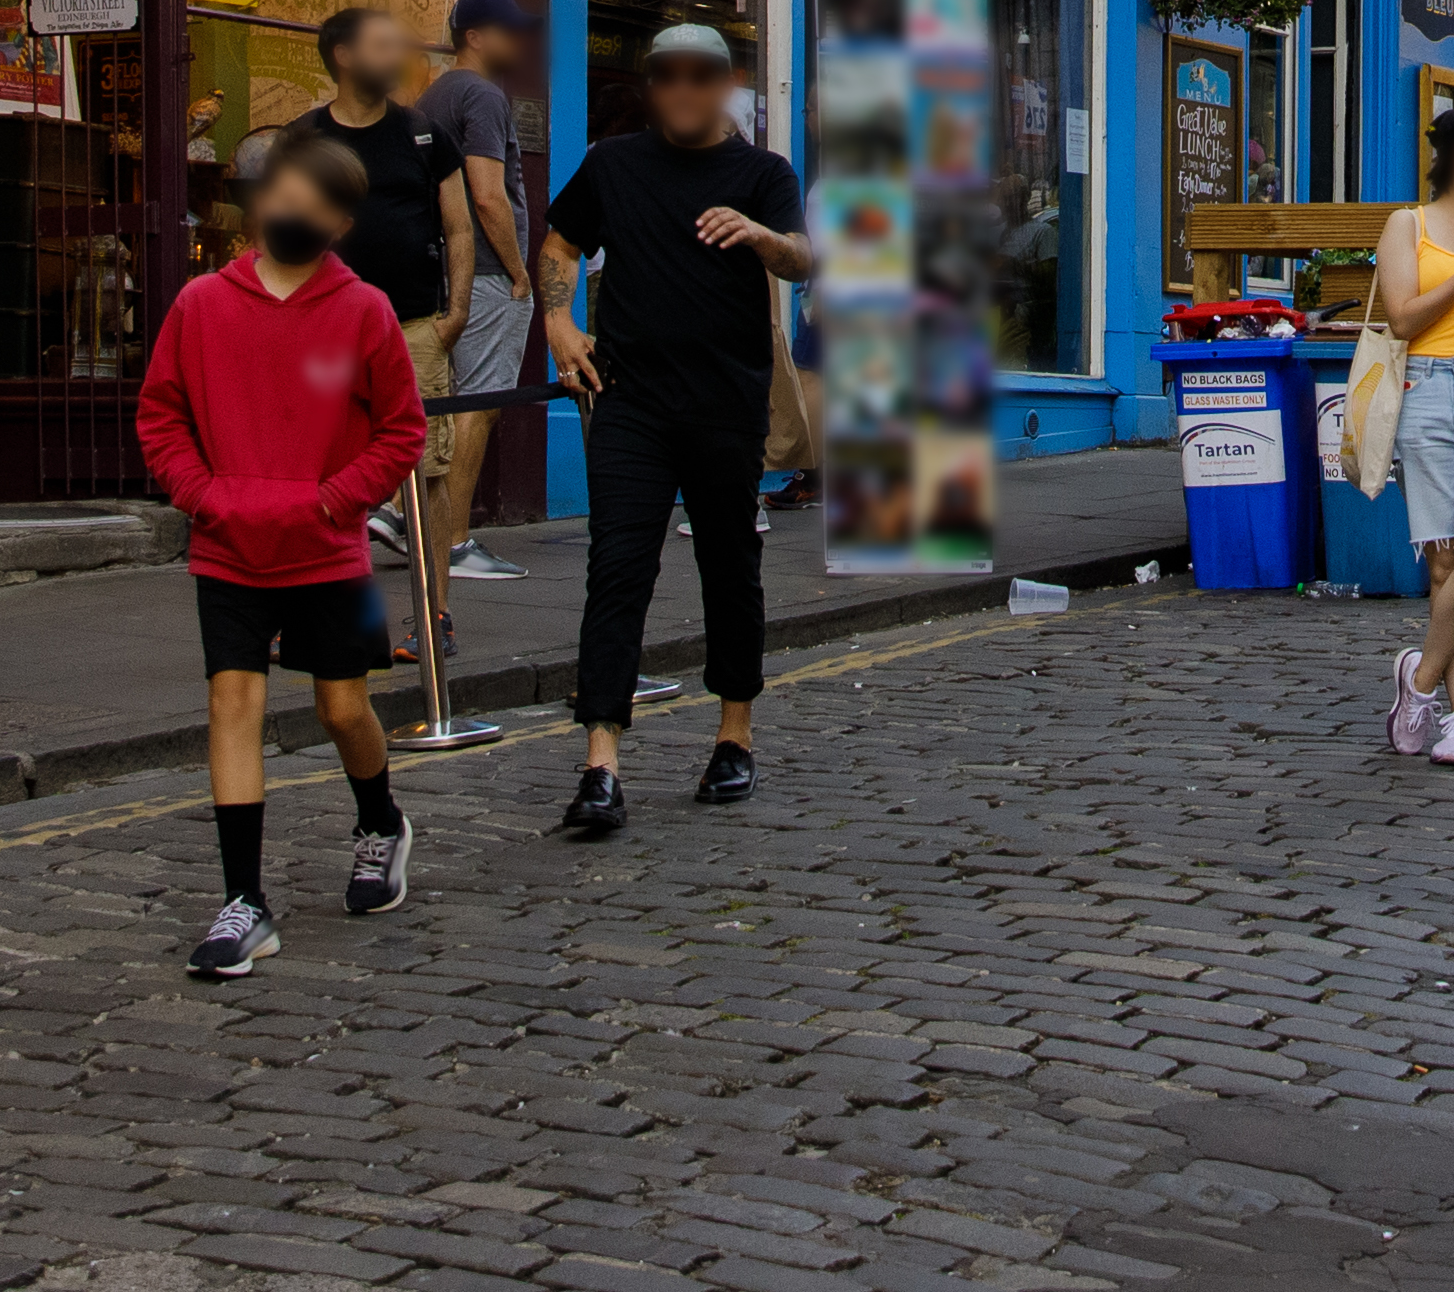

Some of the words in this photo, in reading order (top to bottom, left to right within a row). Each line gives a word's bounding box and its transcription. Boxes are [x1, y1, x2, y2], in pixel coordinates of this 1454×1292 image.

[58, 11, 110, 23] EDINBURGH
[16, 74, 54, 87] POTER
[1186, 88, 1222, 105] MENU
[1177, 104, 1204, 135] Great
[1204, 106, 1227, 138] Value
[1179, 131, 1220, 163] LUNCH
[1183, 374, 1197, 385] NO
[1199, 373, 1233, 385] BLACK
[1236, 373, 1265, 385] BAGS
[1184, 395, 1211, 407] GLASS
[1212, 395, 1241, 406] WASTE
[1242, 394, 1265, 406] ONLY
[1194, 442, 1255, 458] Tartan
[1325, 468, 1339, 479] NO
